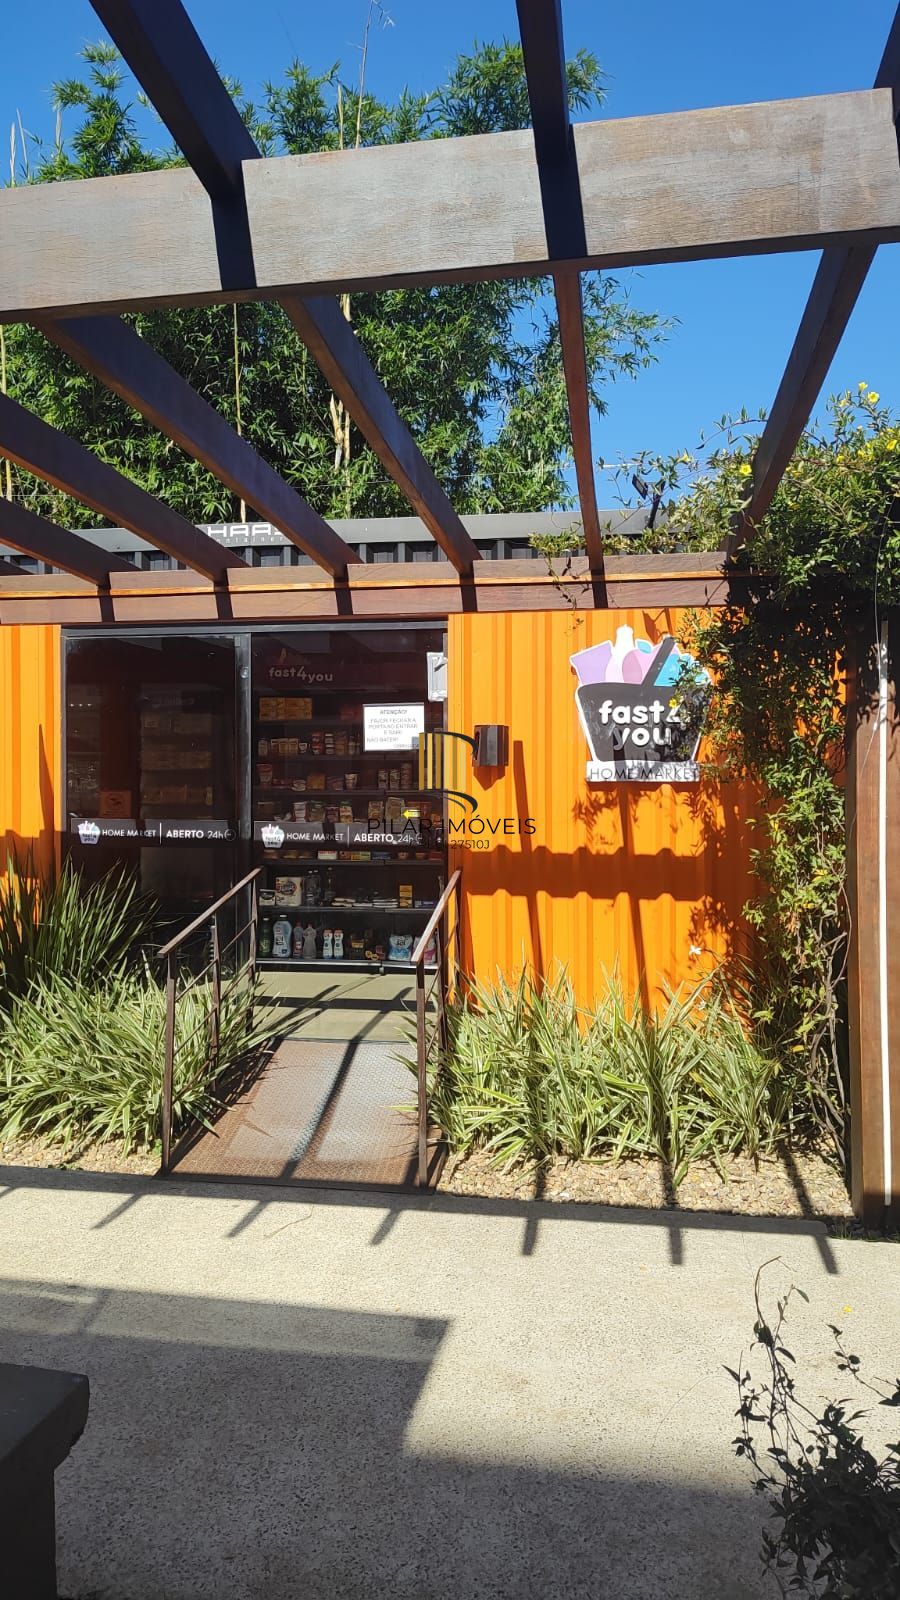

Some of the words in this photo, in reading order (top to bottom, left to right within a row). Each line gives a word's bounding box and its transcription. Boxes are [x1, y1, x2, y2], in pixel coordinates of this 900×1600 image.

[613, 726, 672, 751] you
[589, 767, 634, 780] HOME
[640, 767, 699, 780] MARKET
[102, 829, 125, 837] HOME
[165, 829, 204, 839] ABERTO
[207, 830, 224, 840] 24h
[286, 832, 311, 841] HOME
[312, 832, 345, 841] MARKET
[353, 833, 394, 842] ABERTO
[397, 834, 414, 843] 24h
